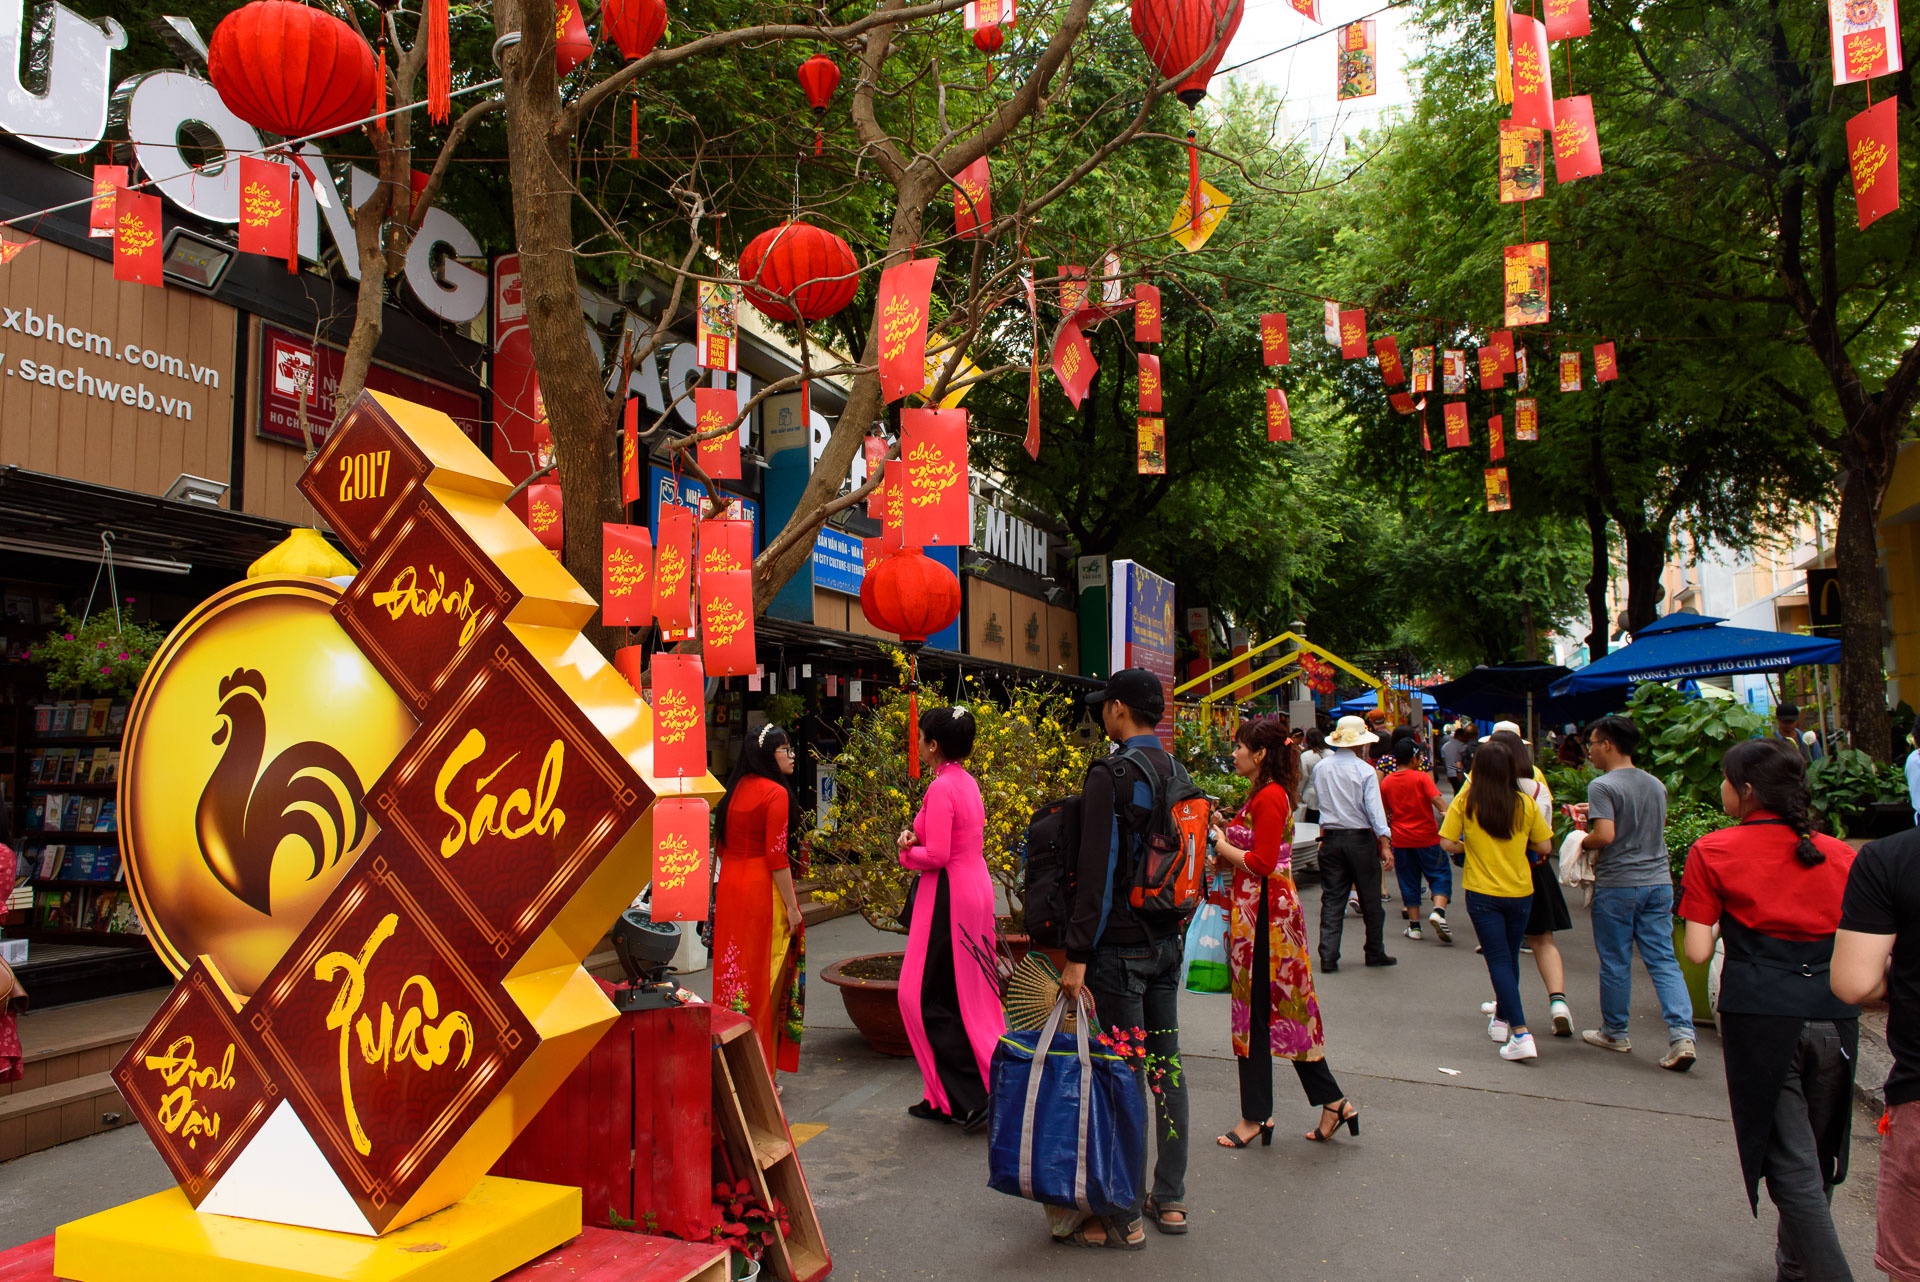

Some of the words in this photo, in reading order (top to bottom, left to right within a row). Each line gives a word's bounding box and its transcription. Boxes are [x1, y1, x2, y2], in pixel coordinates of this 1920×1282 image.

[0, 352, 193, 421] .sachweb.vn
[339, 450, 391, 502] 2017
[984, 504, 1047, 576] MINH
[1759, 655, 1792, 667] MINH
[434, 728, 566, 859] Sách
